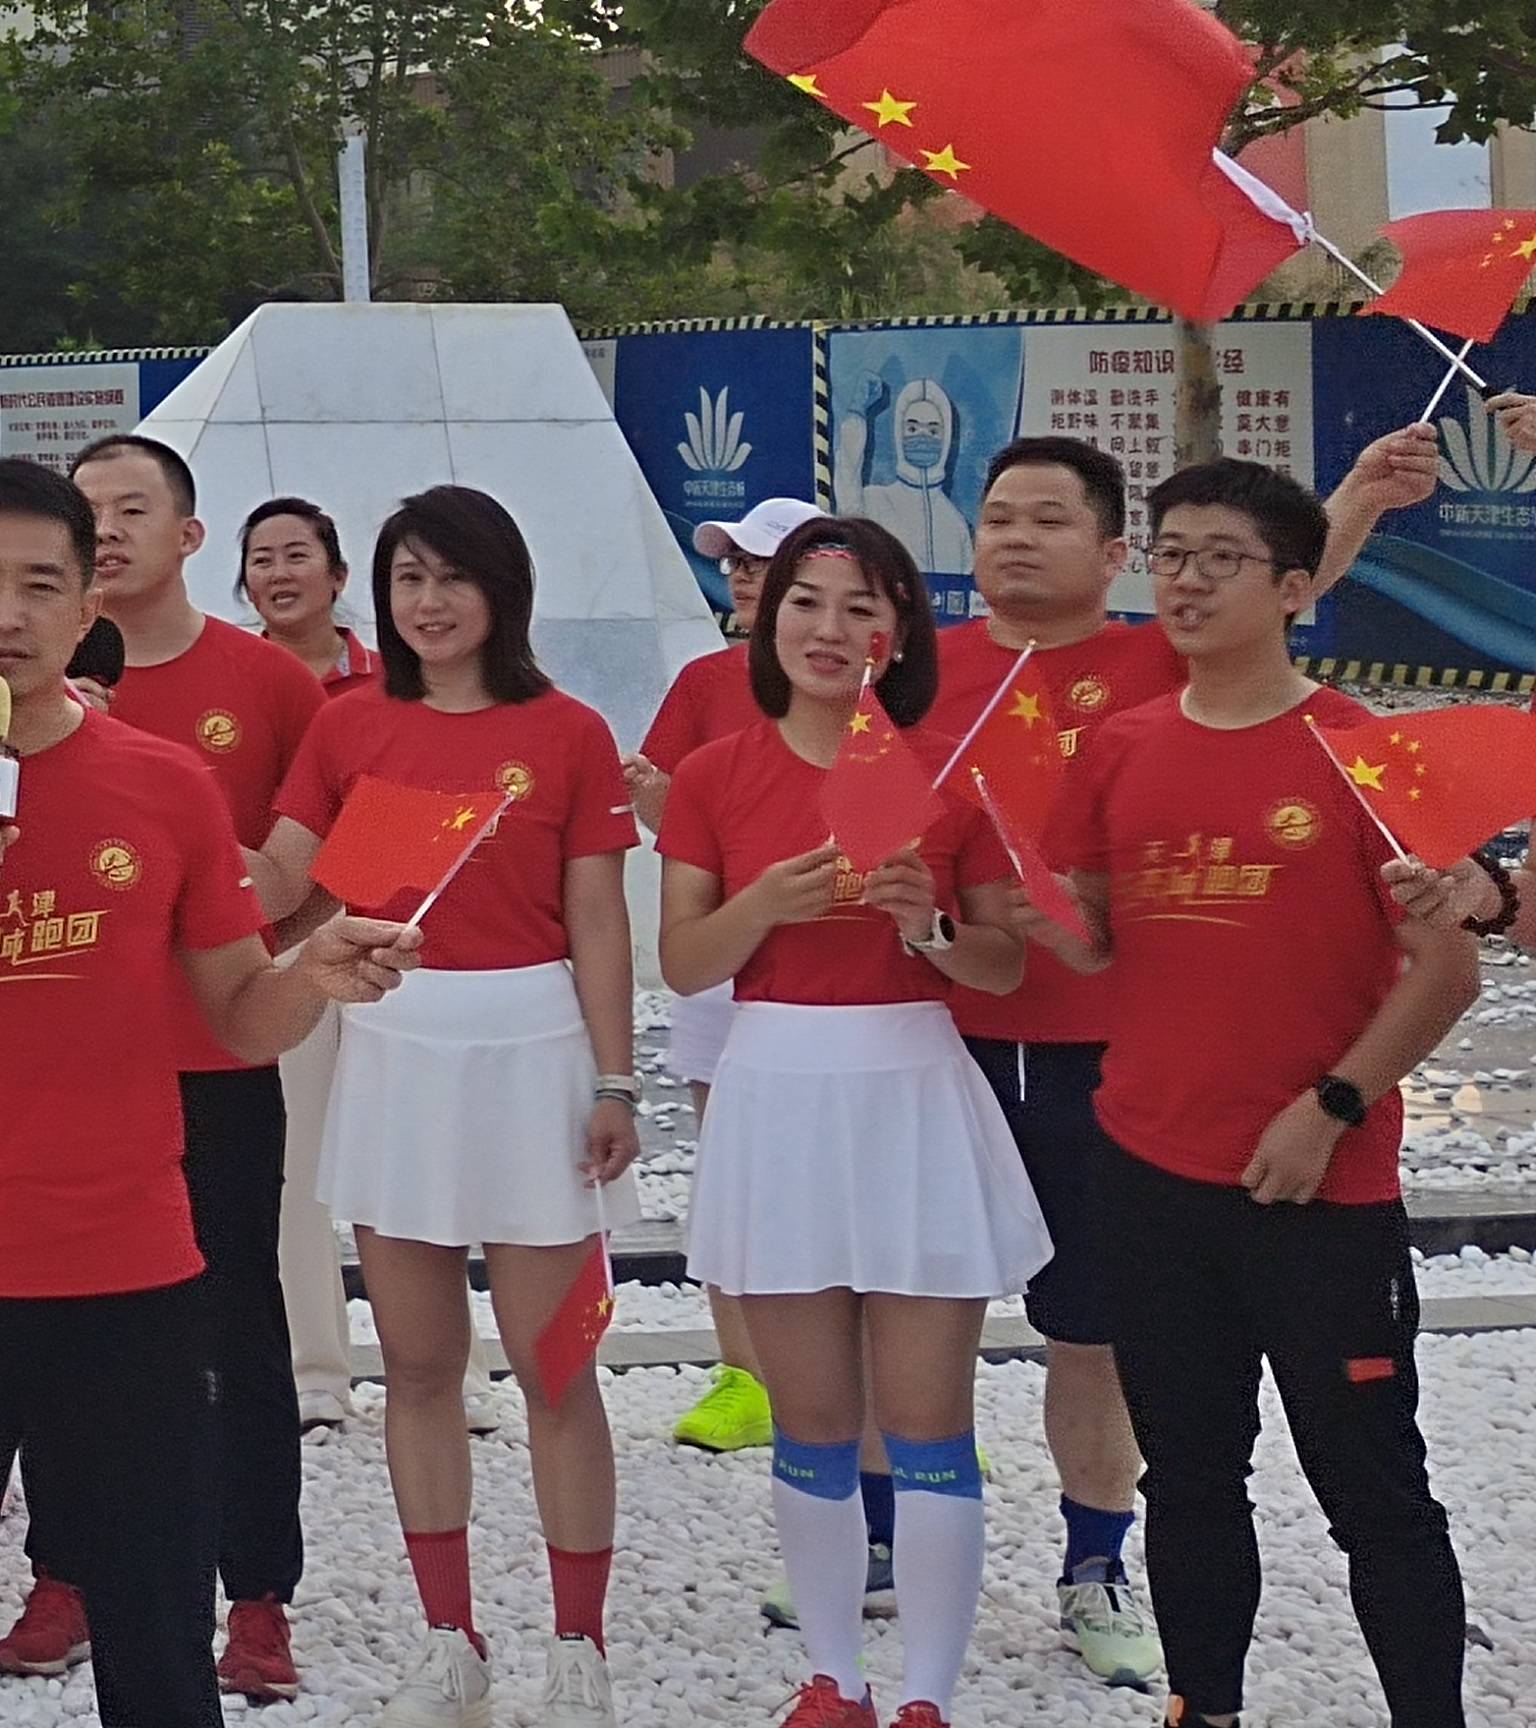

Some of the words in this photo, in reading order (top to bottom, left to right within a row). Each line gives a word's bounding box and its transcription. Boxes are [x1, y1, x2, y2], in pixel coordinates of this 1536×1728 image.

[1439, 503, 1536, 527] 中新天津生态
